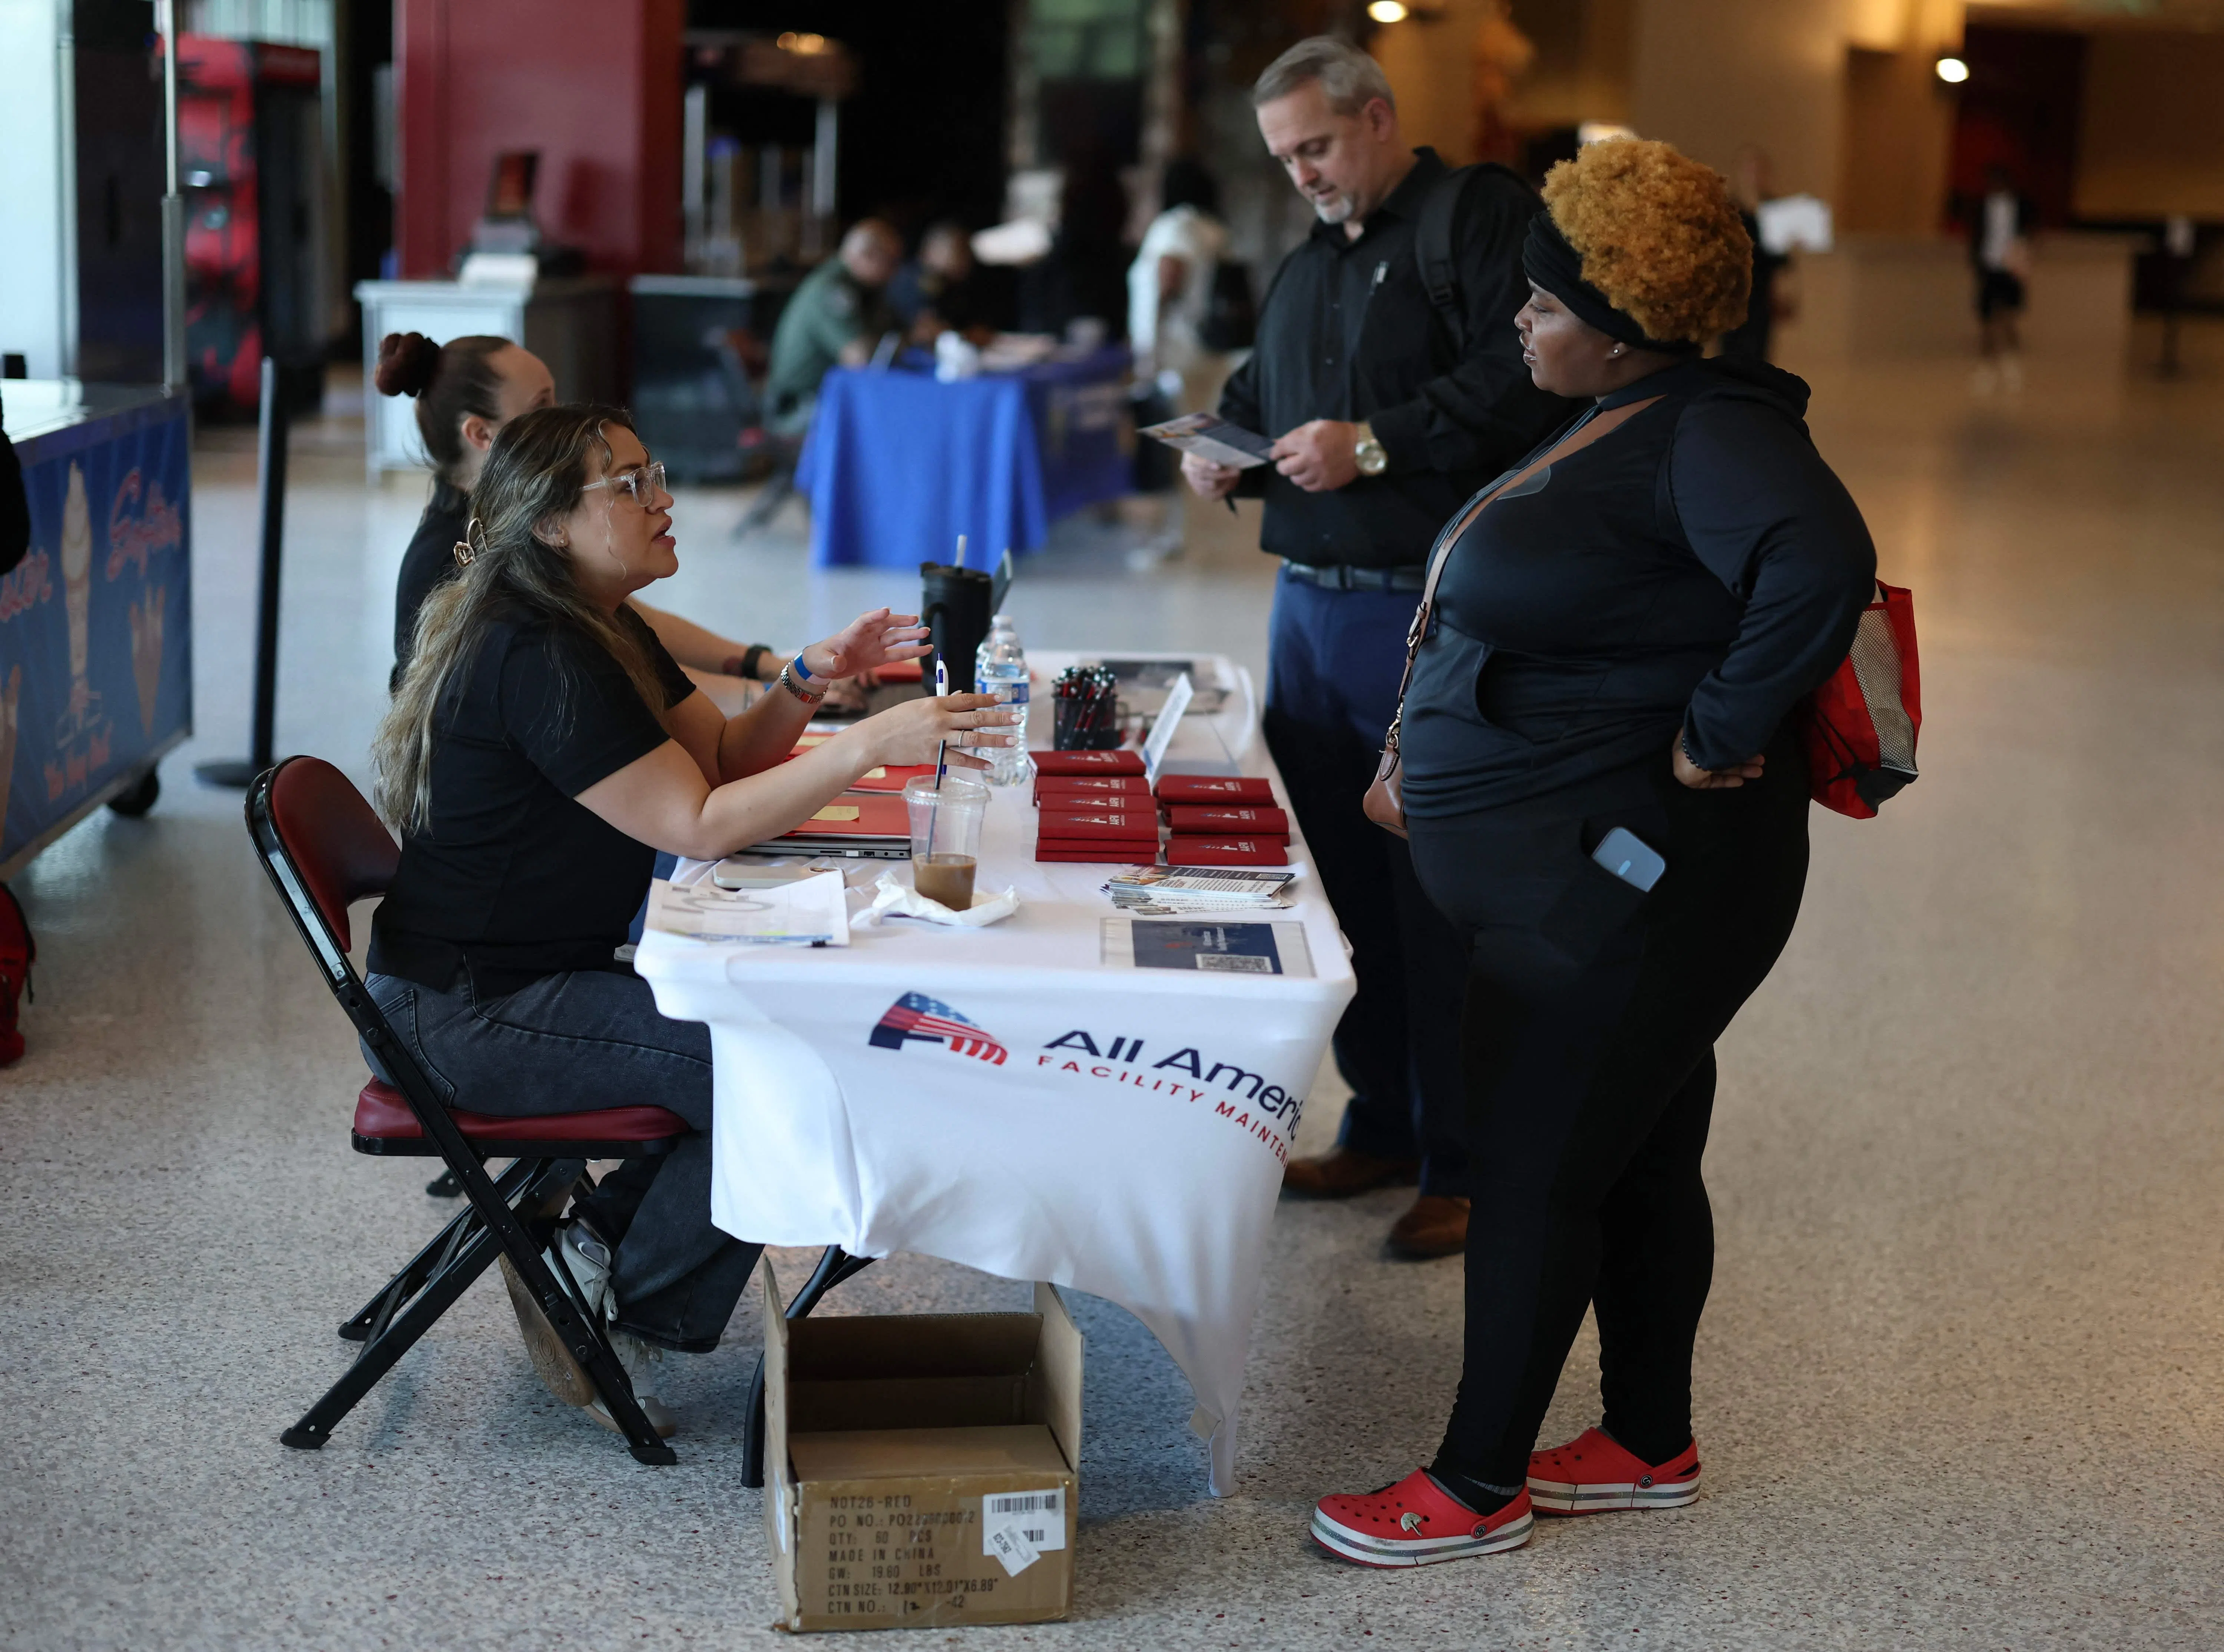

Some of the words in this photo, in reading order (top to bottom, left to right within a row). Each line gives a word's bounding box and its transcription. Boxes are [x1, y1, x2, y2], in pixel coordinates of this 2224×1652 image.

[1109, 815, 1120, 825] AAFM
[1238, 842, 1251, 852] AAFM
[1043, 1030, 1144, 1063] All
[1037, 1055, 1204, 1102] FACILITY
[830, 1514, 846, 1527] PO
[909, 1530, 931, 1543] PCS
[829, 1549, 863, 1562] MADE
[873, 1549, 886, 1560] IN
[895, 1547, 934, 1561] CHINA
[919, 1563, 941, 1577] LBS
[828, 1584, 850, 1597] CTN
[854, 1583, 882, 1596] SIZE:
[828, 1601, 851, 1613] CTN
